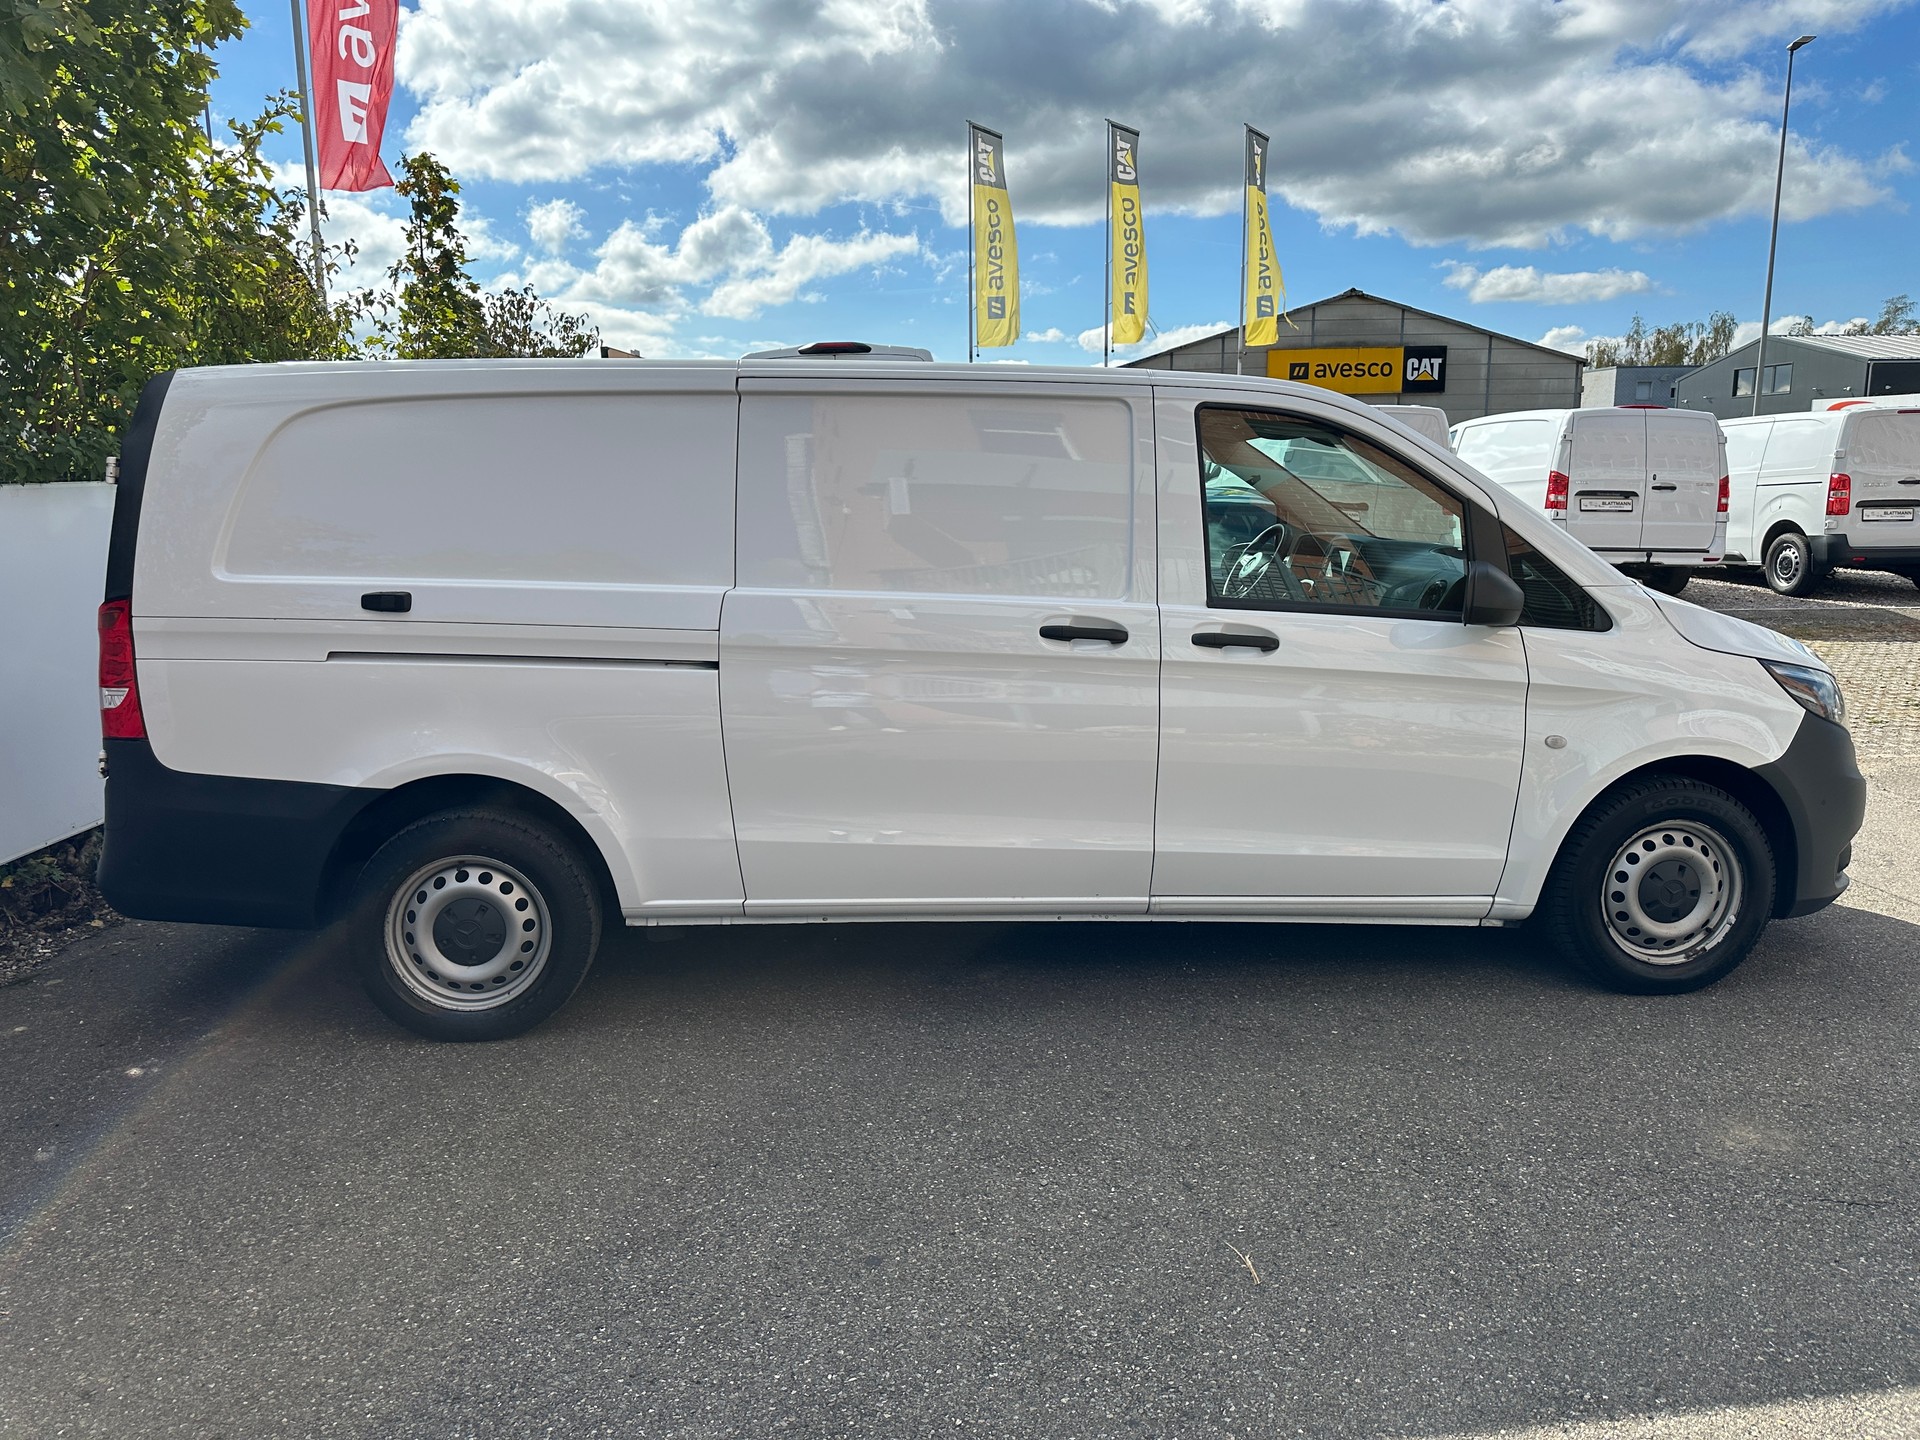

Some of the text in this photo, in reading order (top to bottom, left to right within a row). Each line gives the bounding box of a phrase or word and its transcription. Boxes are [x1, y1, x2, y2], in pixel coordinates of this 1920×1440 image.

[977, 136, 997, 183] CAT
[1116, 135, 1137, 181] CAT
[986, 198, 1005, 291] avesco
[1121, 197, 1139, 286] avesco
[1314, 357, 1443, 381] avesco CAT
